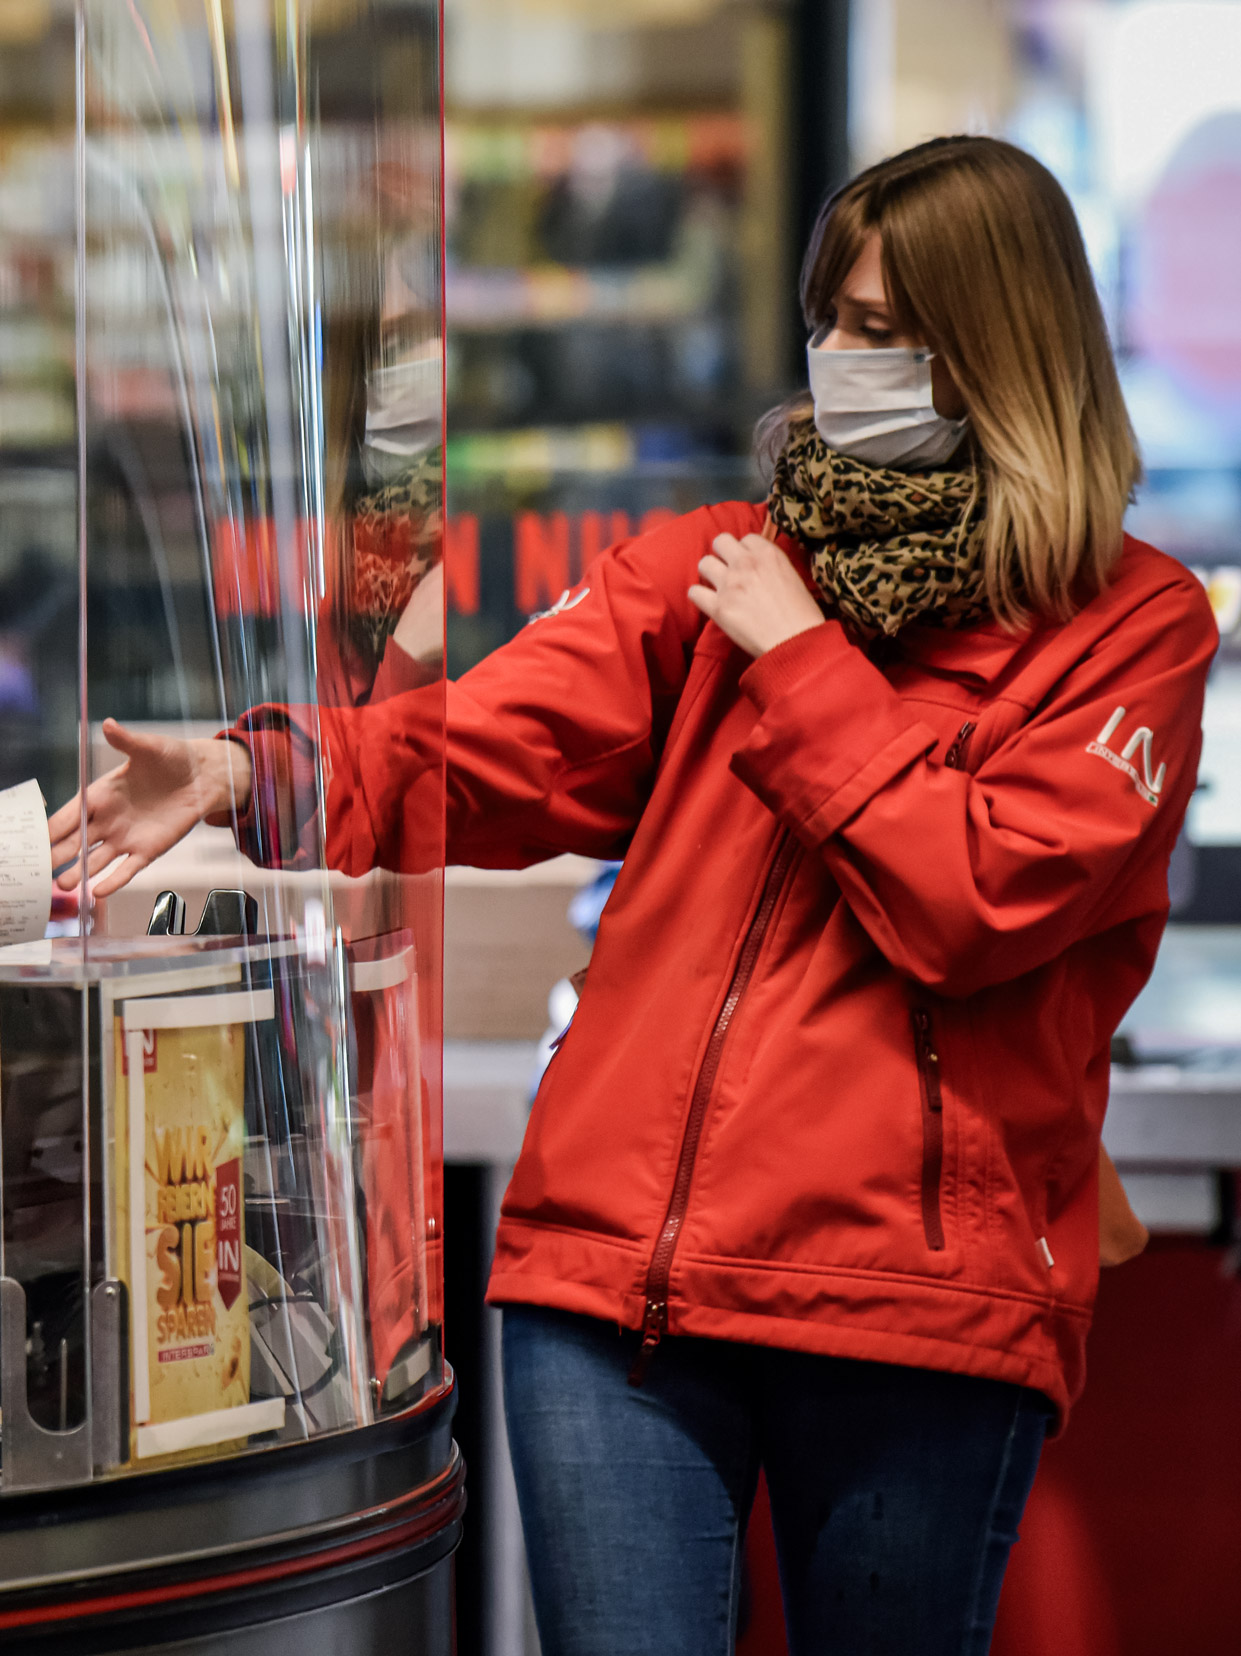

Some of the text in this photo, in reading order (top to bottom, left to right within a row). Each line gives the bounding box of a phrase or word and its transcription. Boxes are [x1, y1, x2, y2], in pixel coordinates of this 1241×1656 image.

[1096, 706, 1167, 794] IN
[155, 1124, 214, 1183] WIR
[157, 1179, 215, 1224] FEIERN
[220, 1184, 237, 1217] 50
[157, 1221, 215, 1311] SIE
[218, 1239, 239, 1272] IN
[157, 1301, 215, 1344] SPAREN
